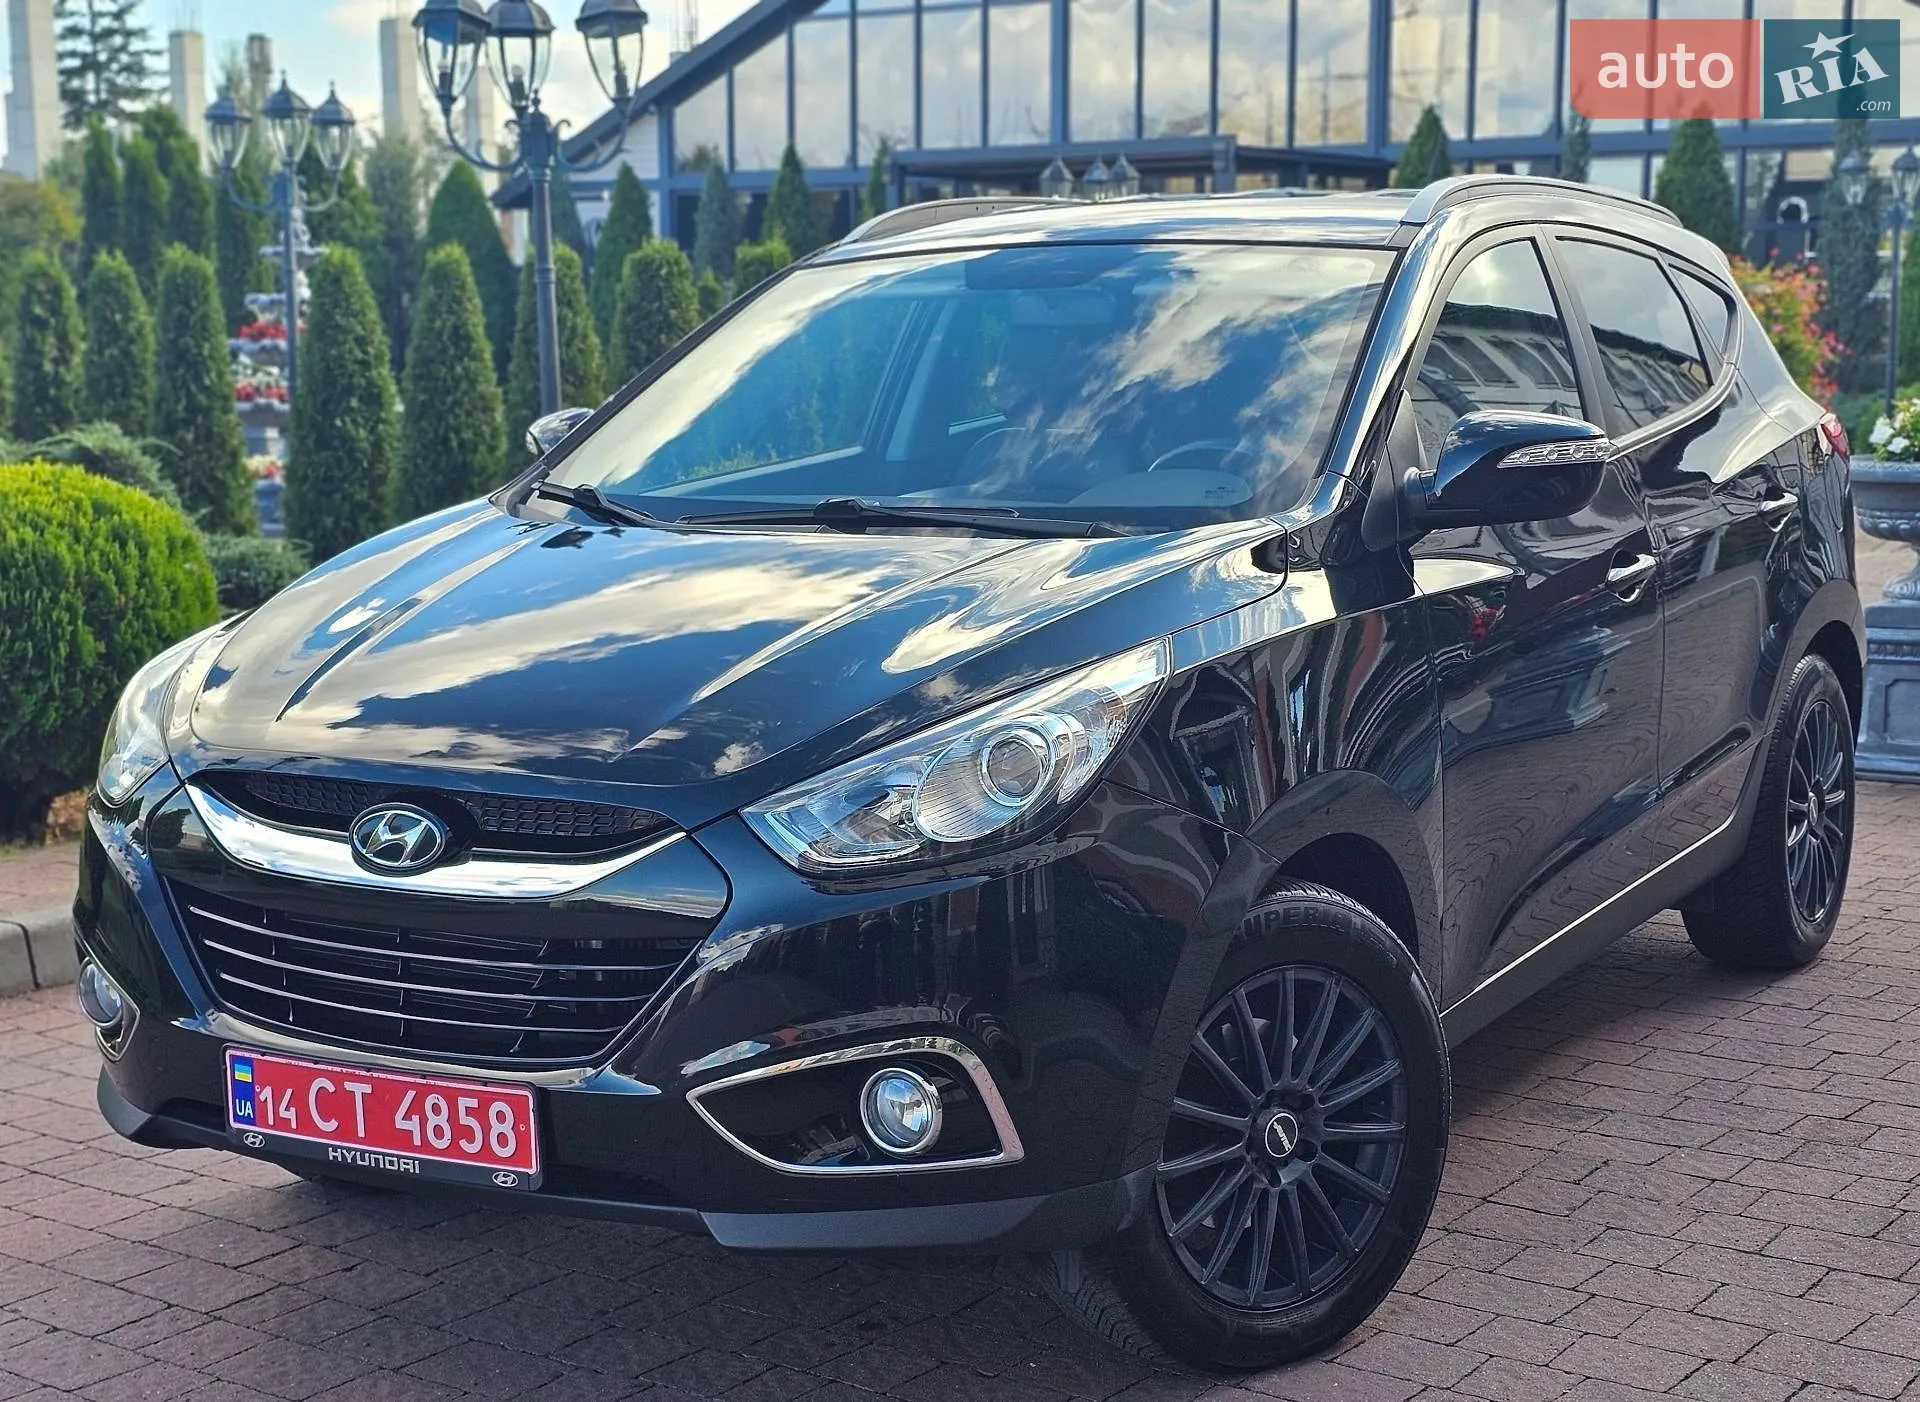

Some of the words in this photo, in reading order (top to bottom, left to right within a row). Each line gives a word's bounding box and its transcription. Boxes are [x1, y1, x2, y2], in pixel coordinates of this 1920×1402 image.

[236, 1098, 254, 1119] UA
[395, 1090, 517, 1158] 4858
[328, 1147, 420, 1174] HYUNDAI
